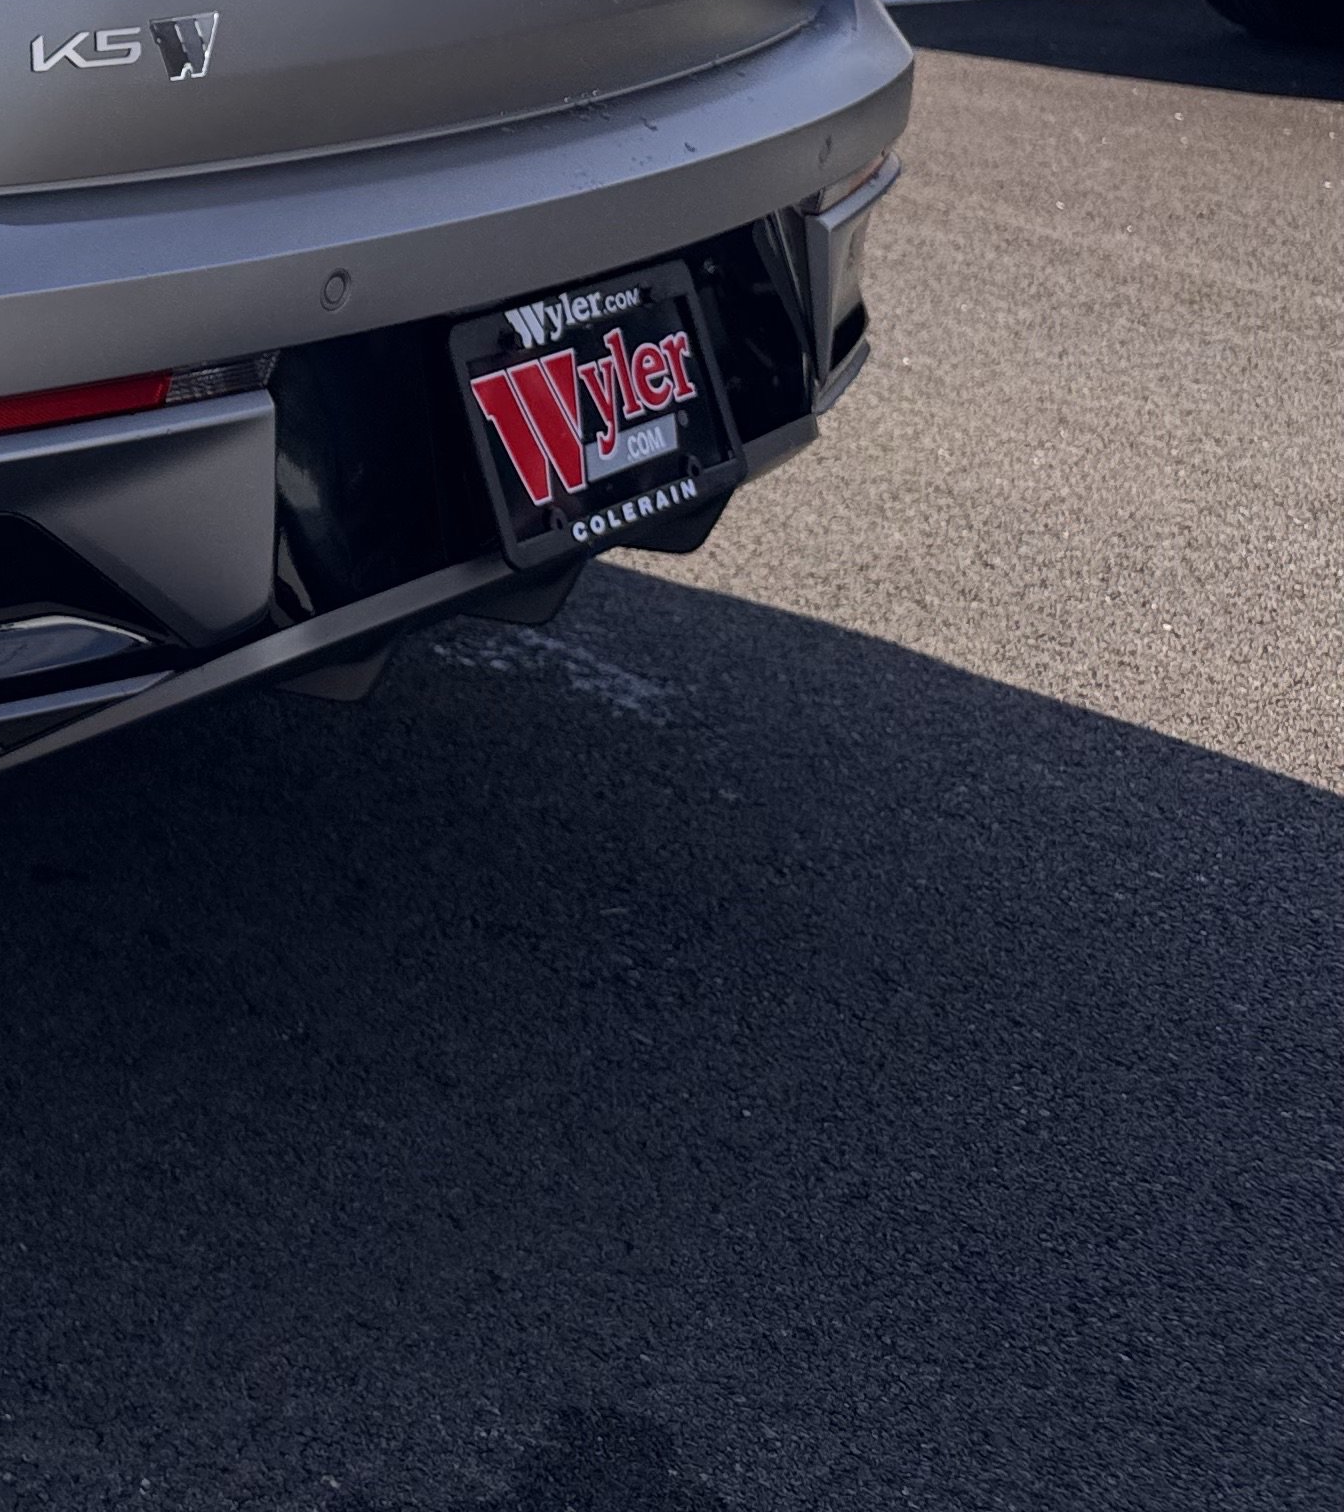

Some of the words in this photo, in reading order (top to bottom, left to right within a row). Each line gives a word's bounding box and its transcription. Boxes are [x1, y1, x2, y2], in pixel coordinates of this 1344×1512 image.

[31, 26, 142, 73] K5
[470, 327, 697, 506] Wyler
[572, 478, 698, 542] COLERAIN
